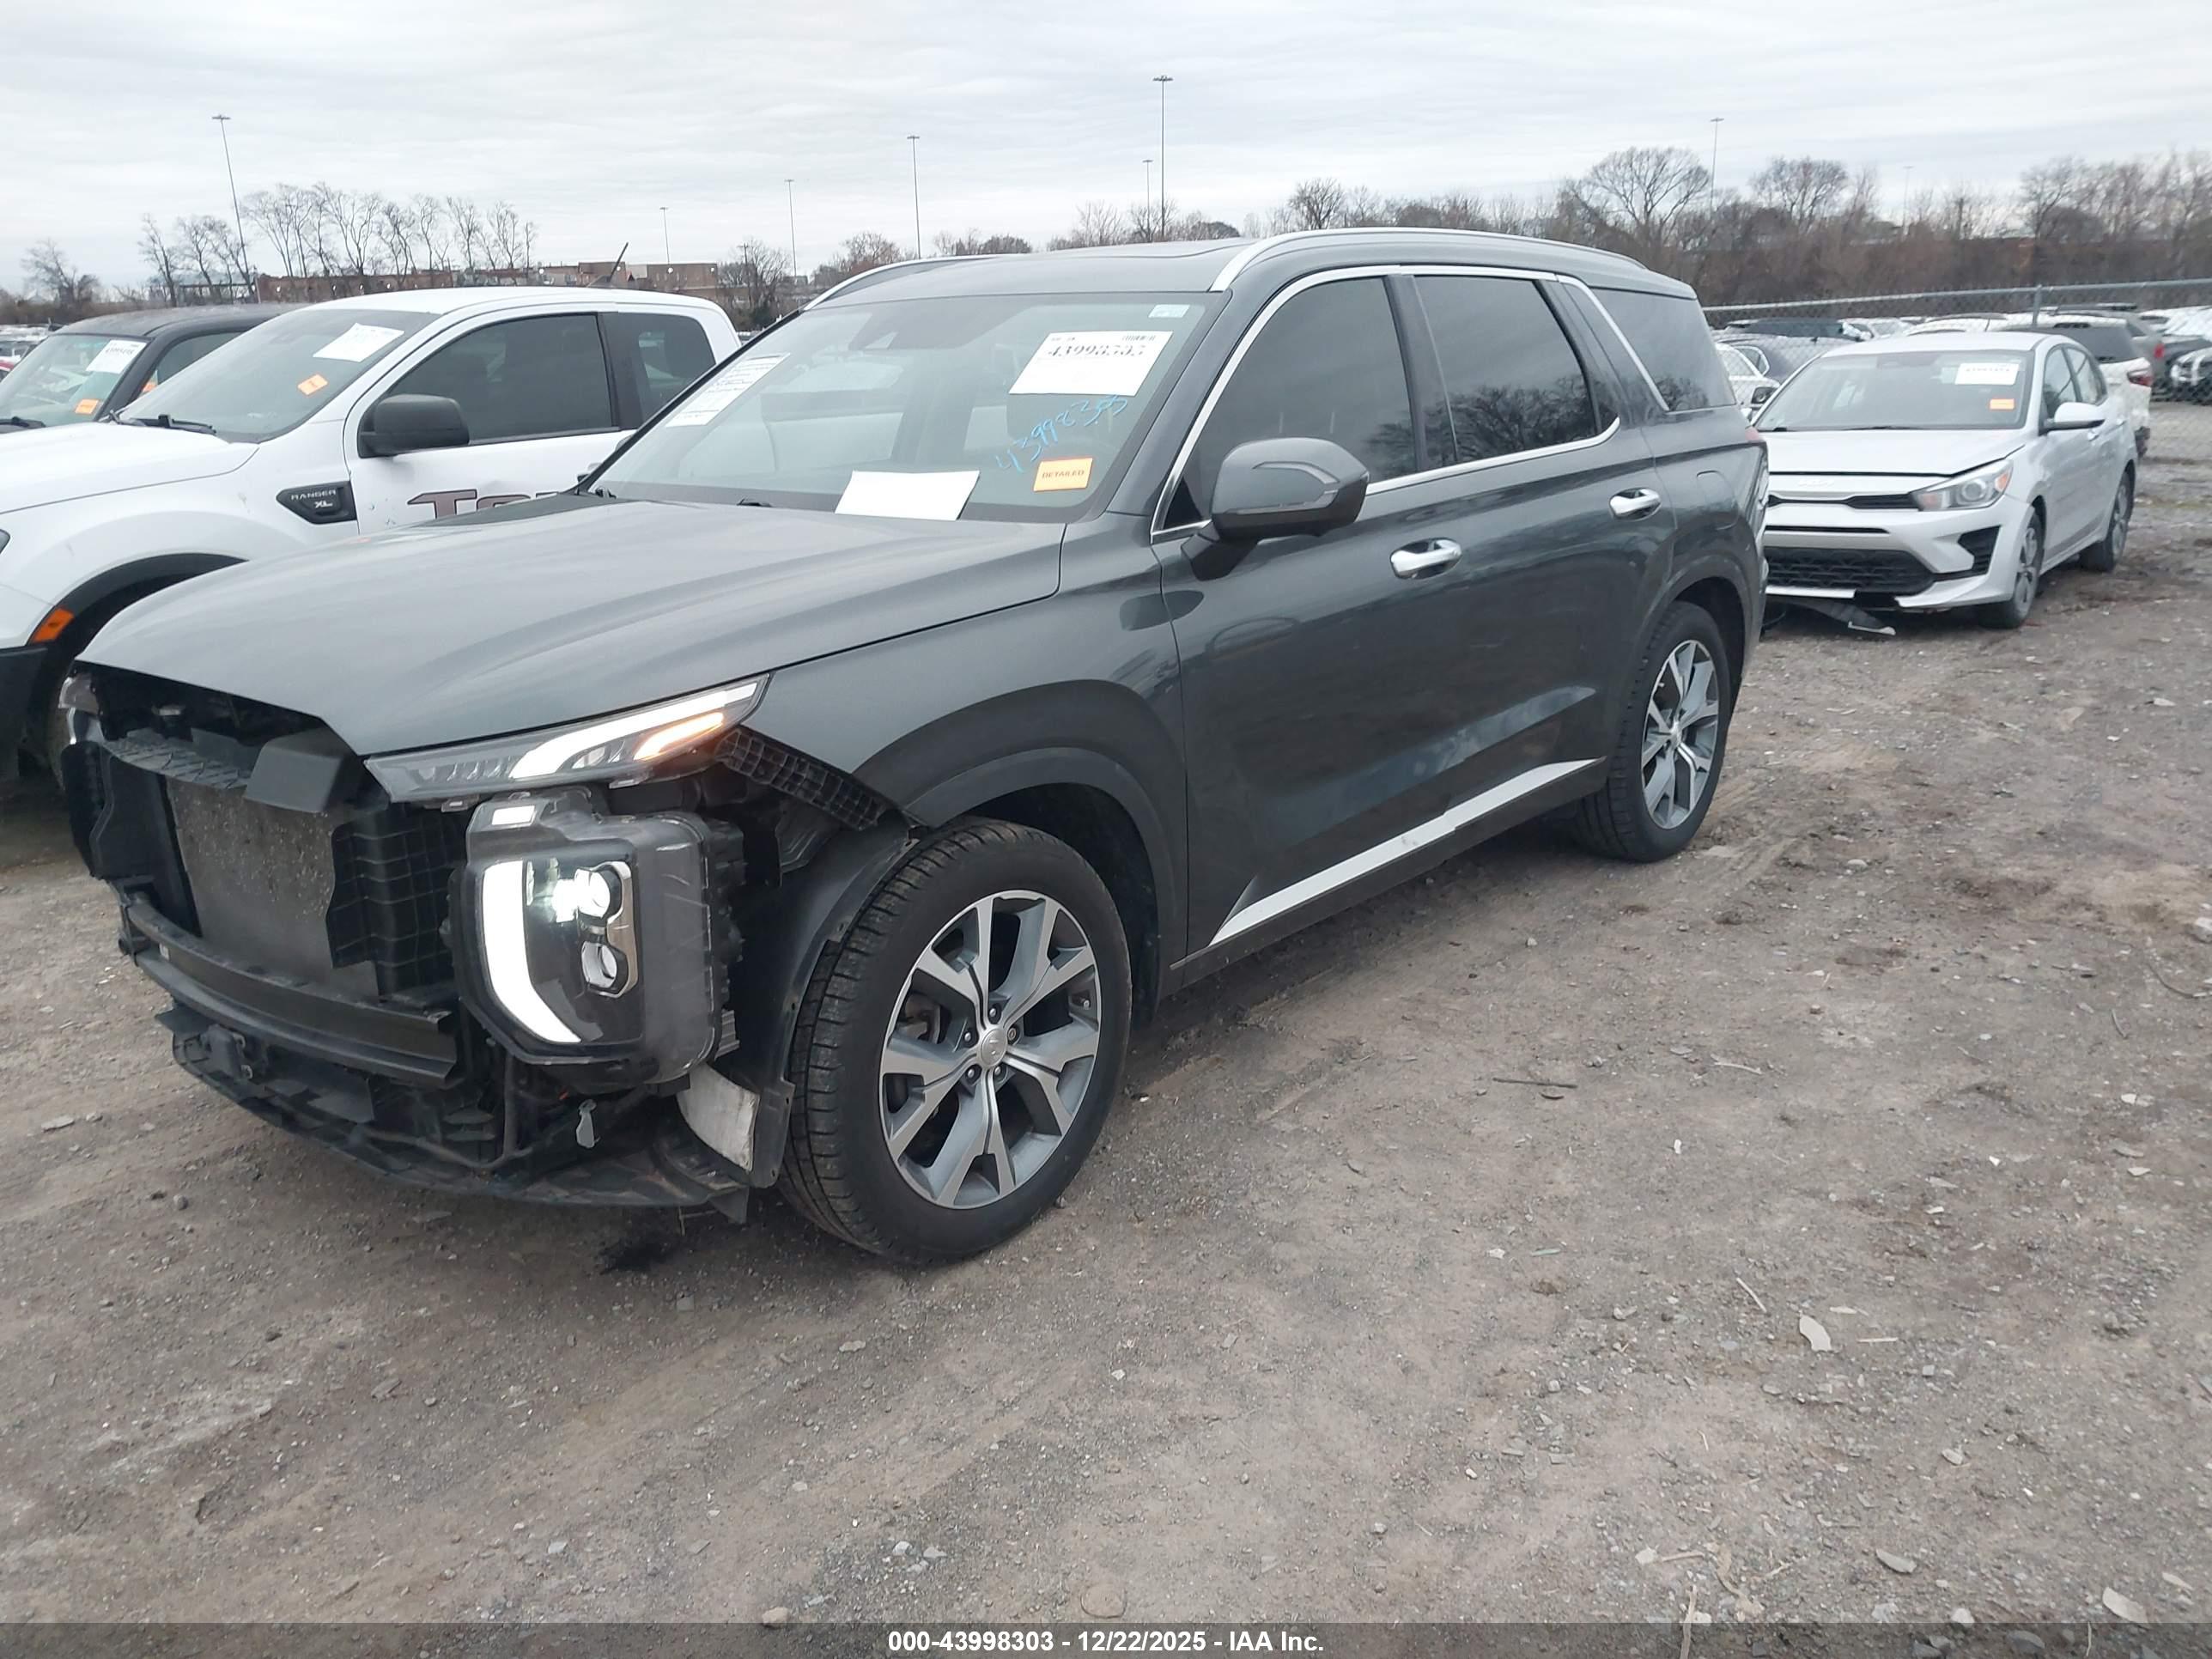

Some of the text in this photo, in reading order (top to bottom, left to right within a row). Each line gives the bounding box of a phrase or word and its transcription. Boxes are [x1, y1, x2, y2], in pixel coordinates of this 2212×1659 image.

[1042, 470, 1085, 479] DETAILED
[291, 489, 337, 501] RANGER
[314, 500, 333, 509] XL
